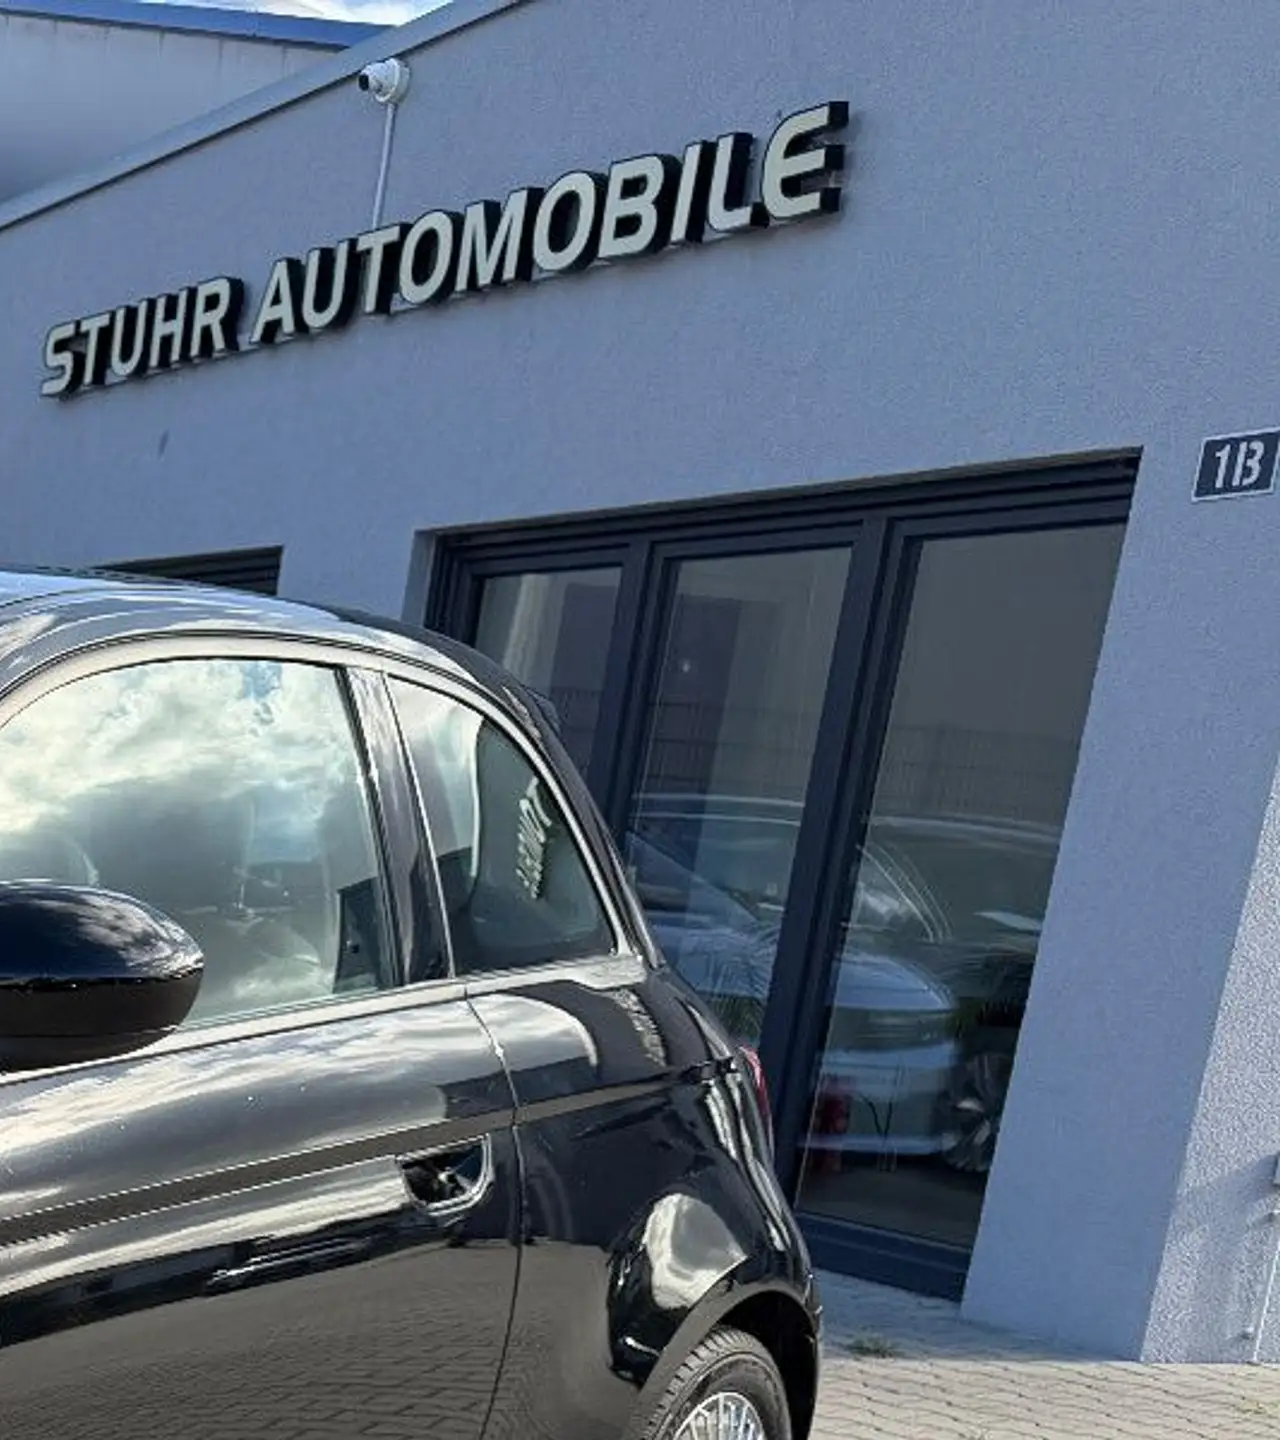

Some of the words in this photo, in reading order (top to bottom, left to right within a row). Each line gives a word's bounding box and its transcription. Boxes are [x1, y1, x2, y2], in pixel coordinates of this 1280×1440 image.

[41, 276, 243, 398] STUHR
[249, 101, 848, 342] AUTOMOBILE
[1215, 441, 1264, 488] 1B
